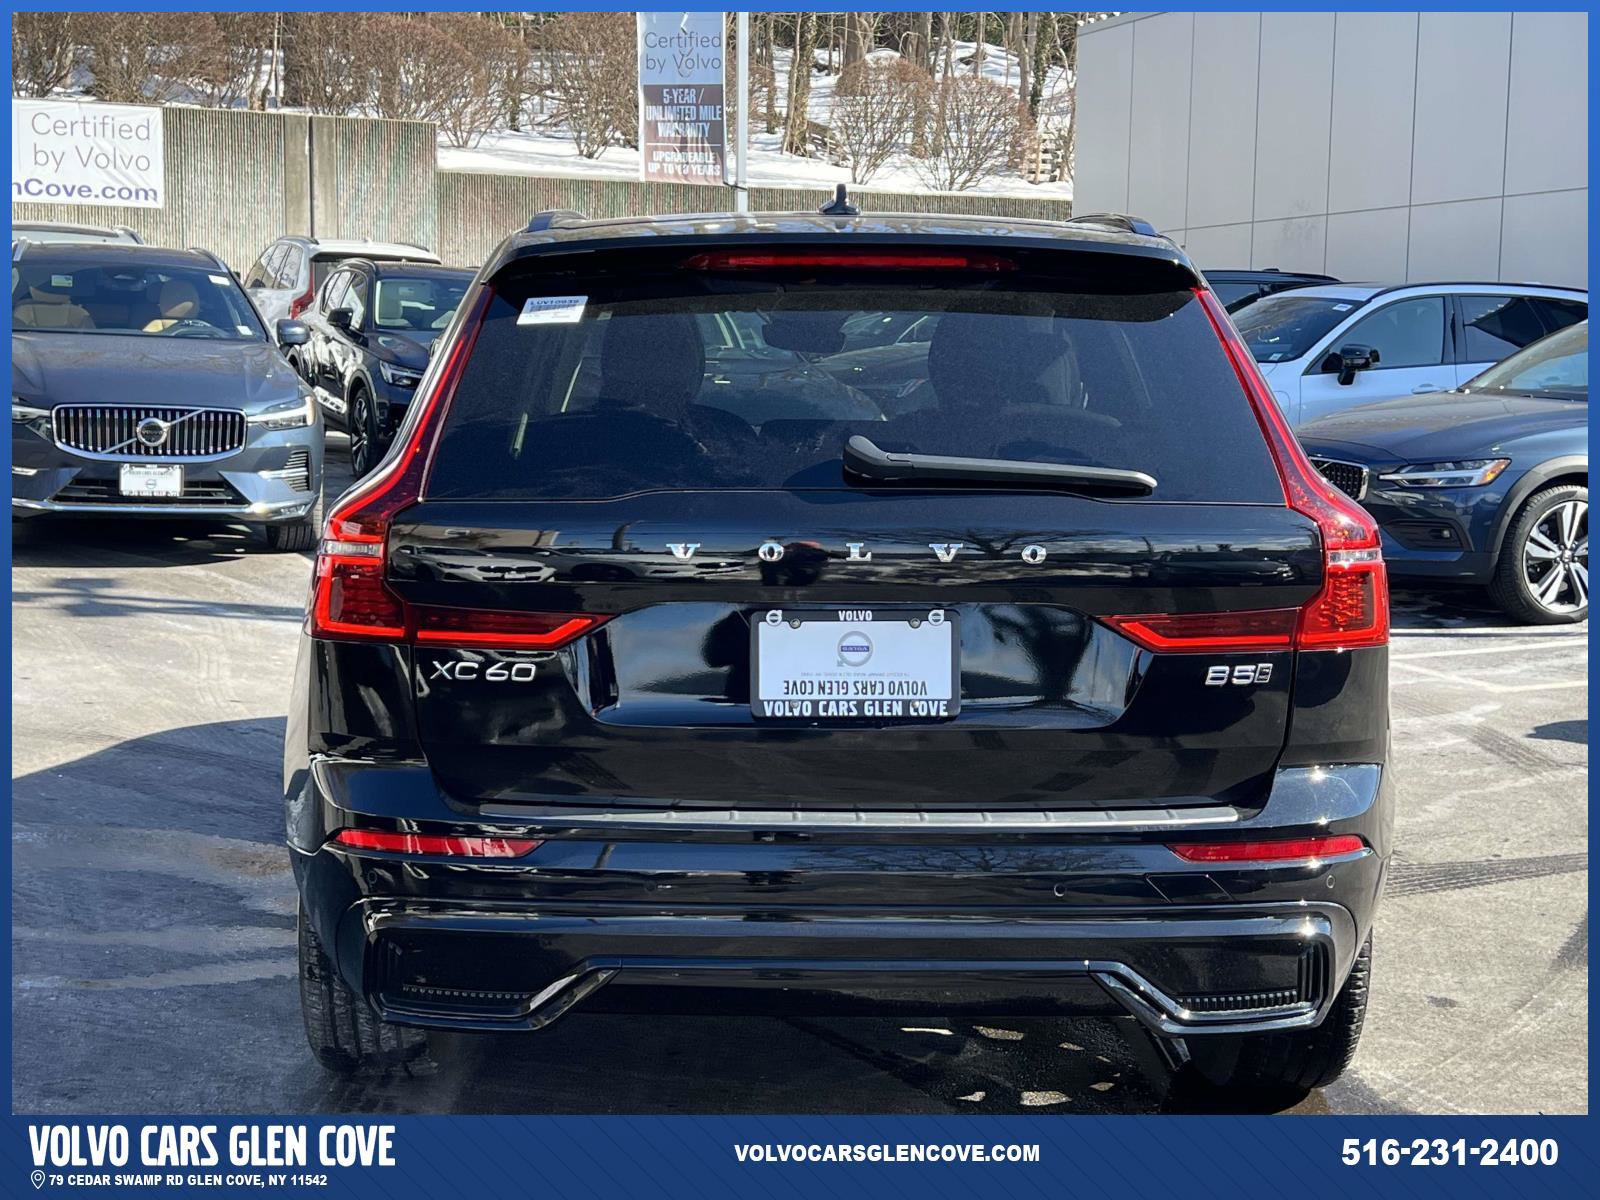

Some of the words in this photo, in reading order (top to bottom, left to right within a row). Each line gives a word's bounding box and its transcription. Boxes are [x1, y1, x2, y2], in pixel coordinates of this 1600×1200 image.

[644, 31, 722, 49] Certified
[646, 53, 666, 74] by
[672, 53, 722, 70] Volvo
[663, 89, 696, 104] 5-YEAR
[646, 105, 696, 121] UNLIMITED
[699, 105, 722, 121] MILE
[31, 112, 150, 141] Certified
[658, 123, 711, 138] WARRANTY
[34, 143, 65, 173] by
[75, 145, 150, 171] Volvo
[653, 151, 716, 164] UPGRADEABLE
[648, 162, 661, 174] UP
[666, 541, 1047, 565] VOLVO
[838, 610, 873, 621] VOLVO
[783, 680, 814, 696] COVE
[818, 680, 849, 696] GLEN
[853, 680, 885, 696] CARS
[889, 680, 928, 696] VOLVO
[763, 701, 812, 717] VOLVO
[818, 701, 858, 717] CARS
[863, 701, 903, 717] GLEN
[909, 701, 948, 717] COVE
